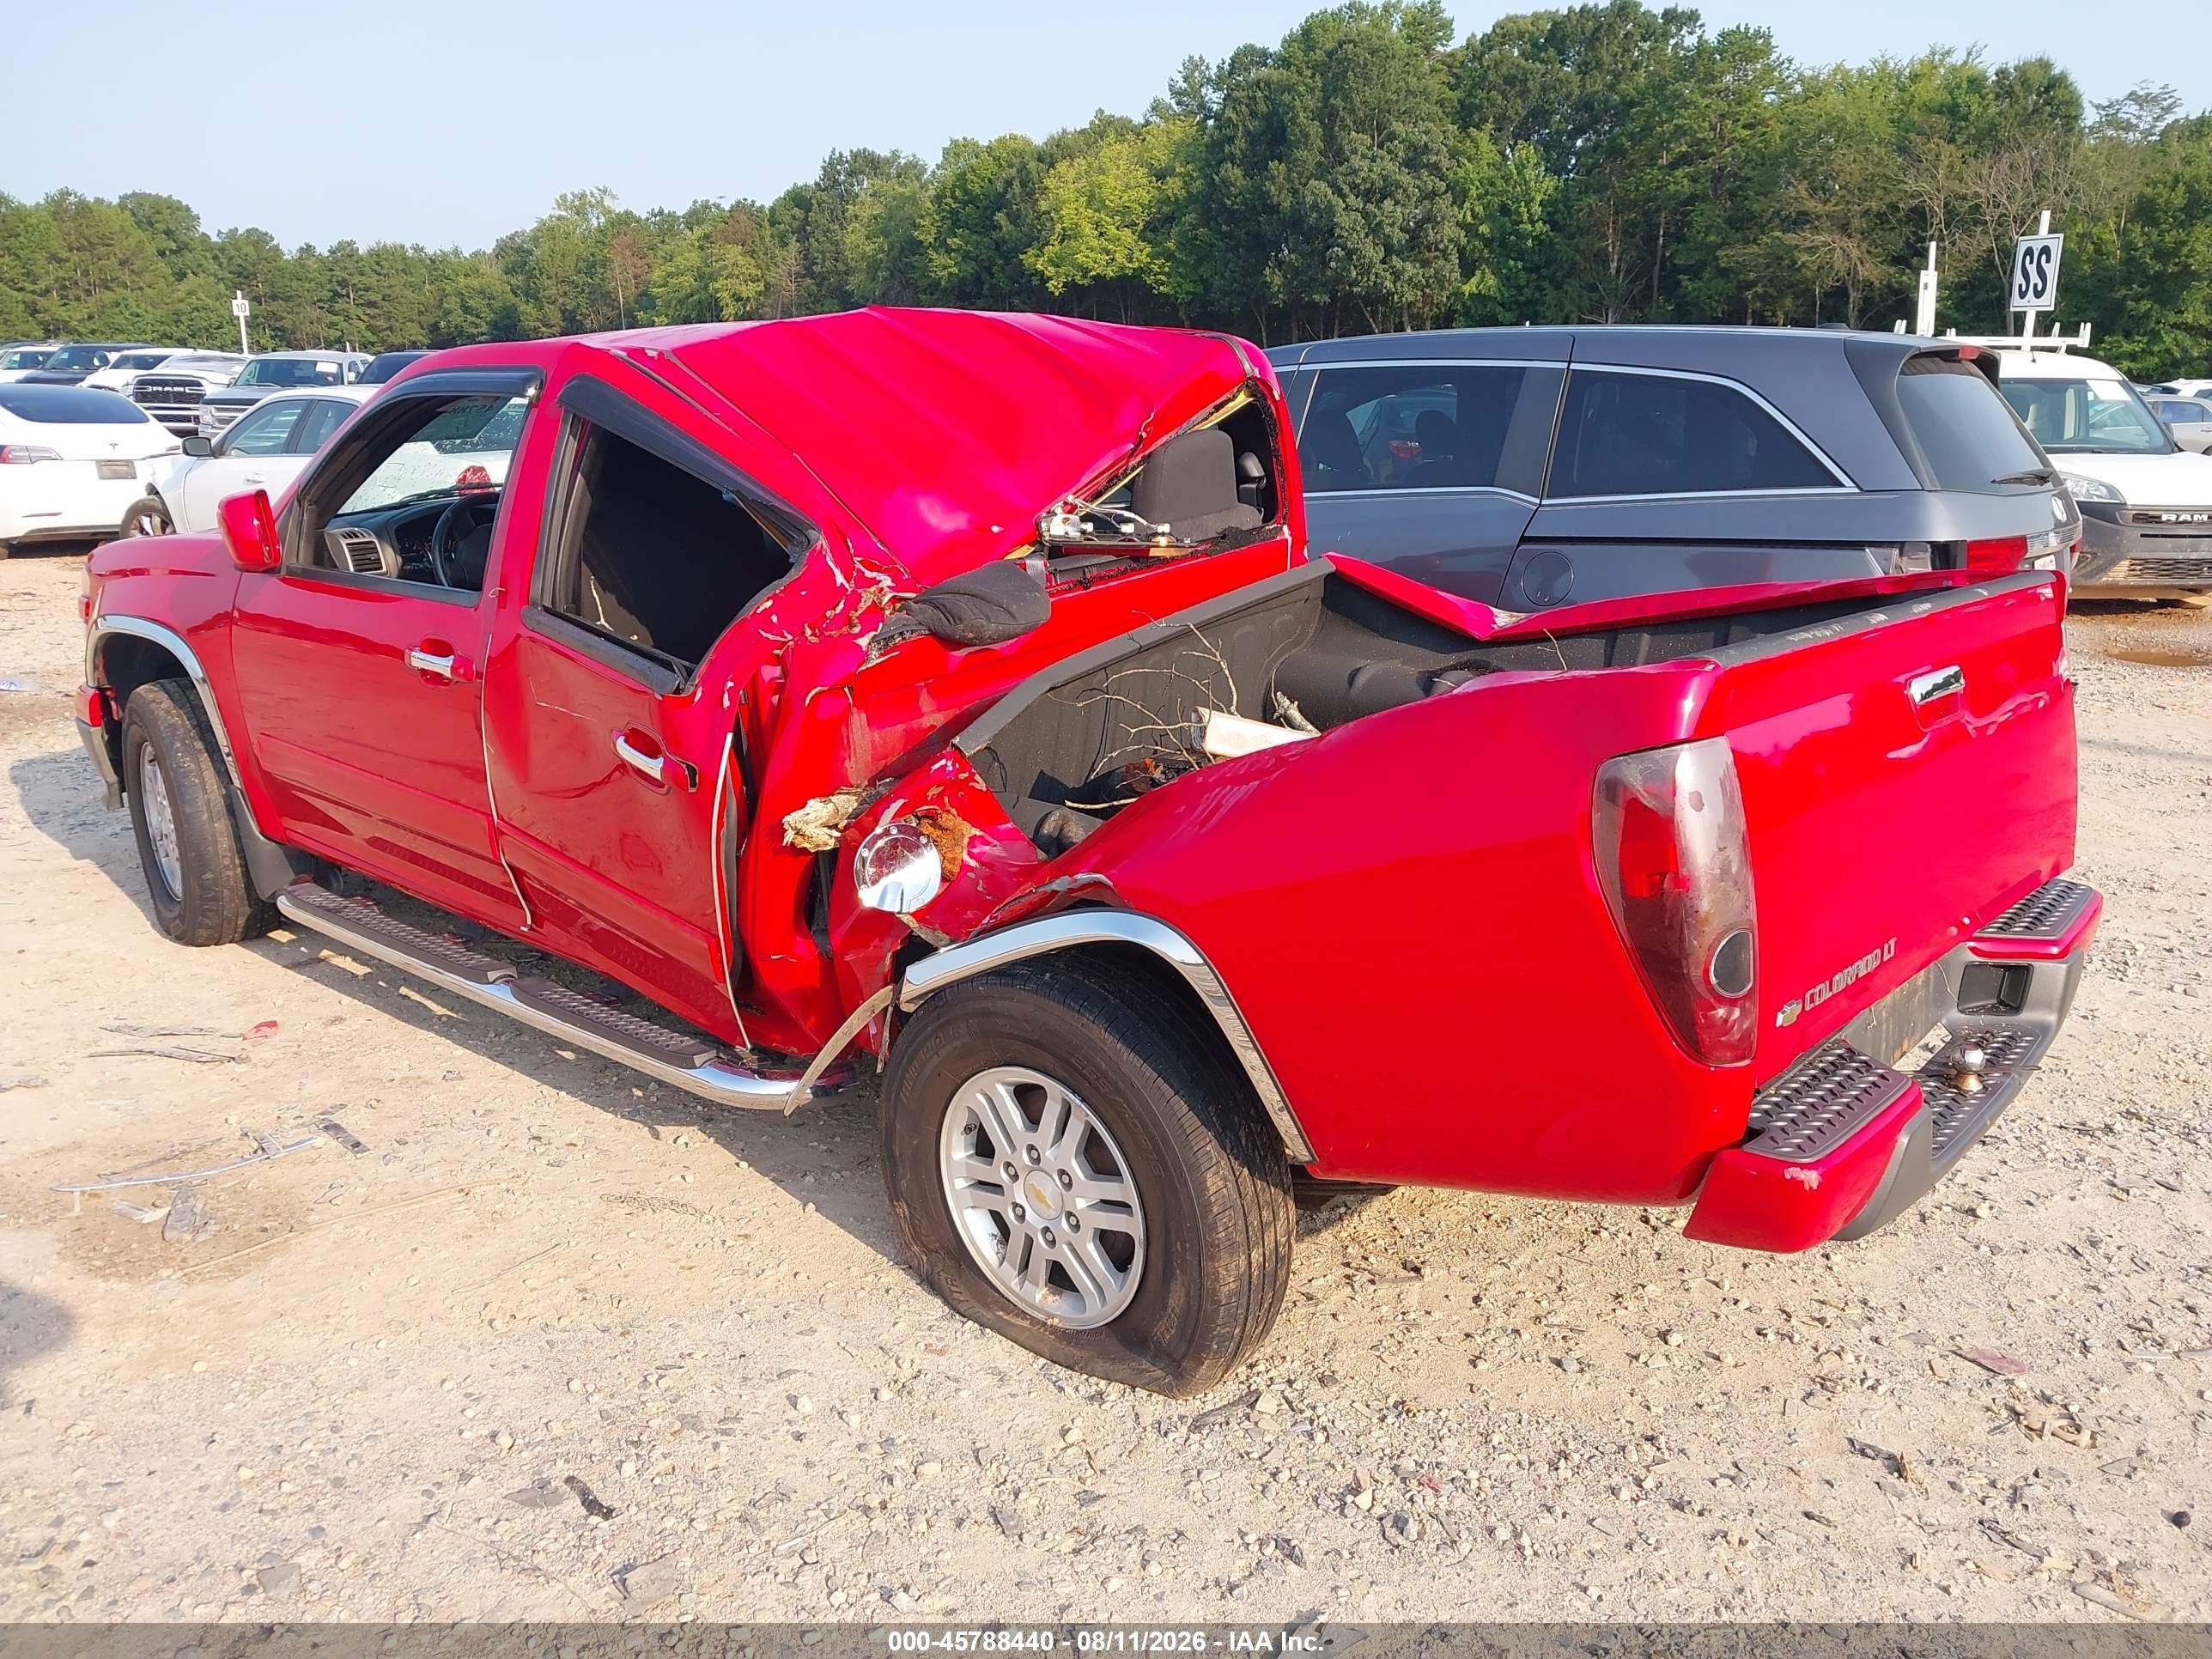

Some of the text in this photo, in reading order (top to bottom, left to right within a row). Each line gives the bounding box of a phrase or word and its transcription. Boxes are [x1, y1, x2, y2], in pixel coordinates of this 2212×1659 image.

[2018, 245, 2051, 300] SS
[235, 303, 246, 313] 10
[1805, 937, 1897, 1012] COLORADO LT
